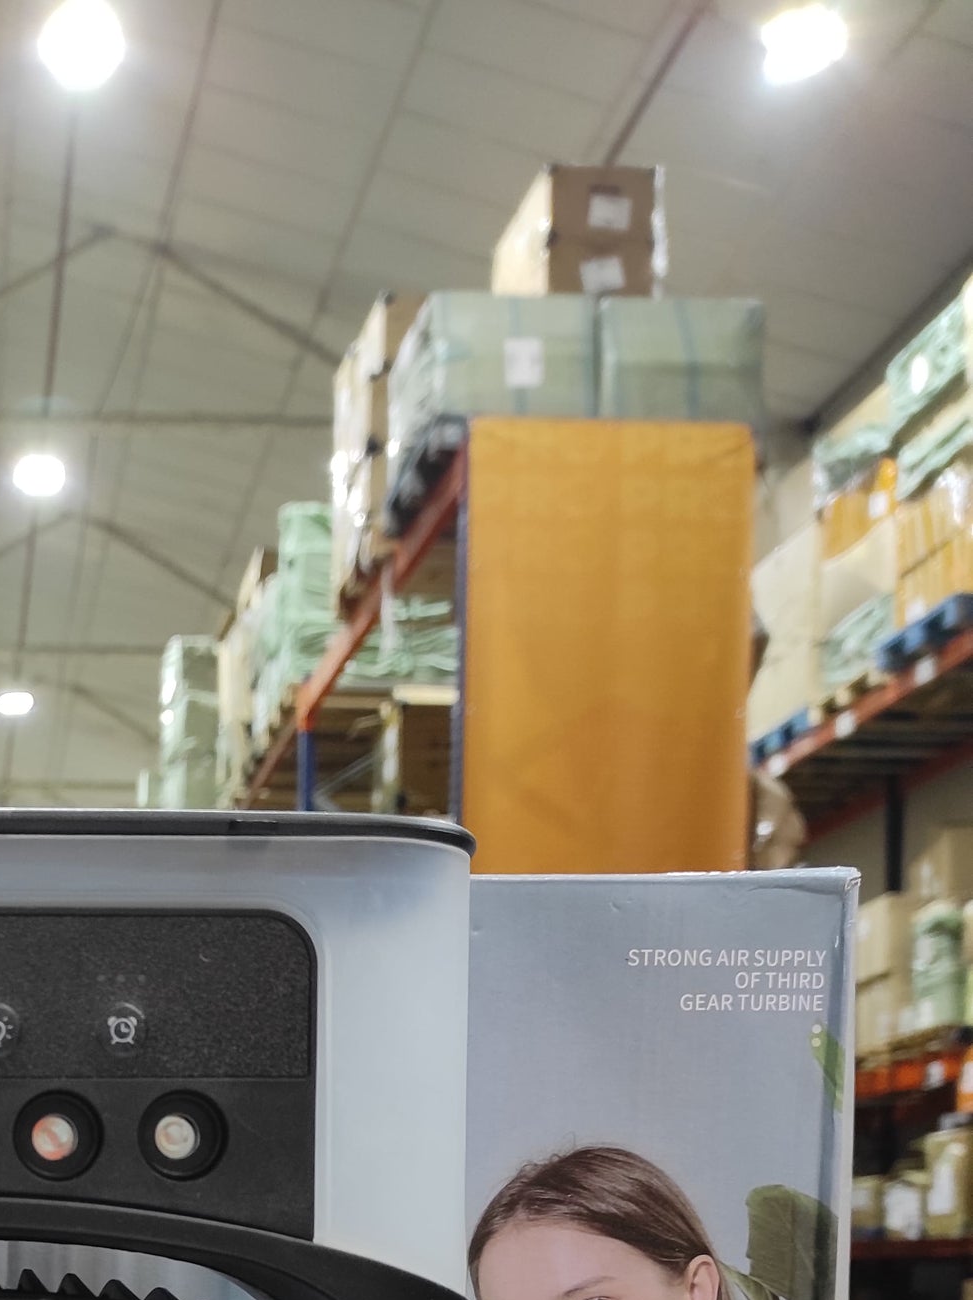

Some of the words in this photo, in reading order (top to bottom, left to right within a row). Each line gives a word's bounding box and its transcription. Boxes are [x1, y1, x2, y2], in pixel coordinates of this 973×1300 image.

[628, 949, 712, 967] STRONG
[716, 949, 749, 967] AIR
[753, 949, 826, 967] SUPPLY
[735, 972, 761, 989] OF
[765, 972, 824, 989] THIRD
[680, 994, 733, 1011] GEAR
[738, 994, 824, 1011] TURBINE
